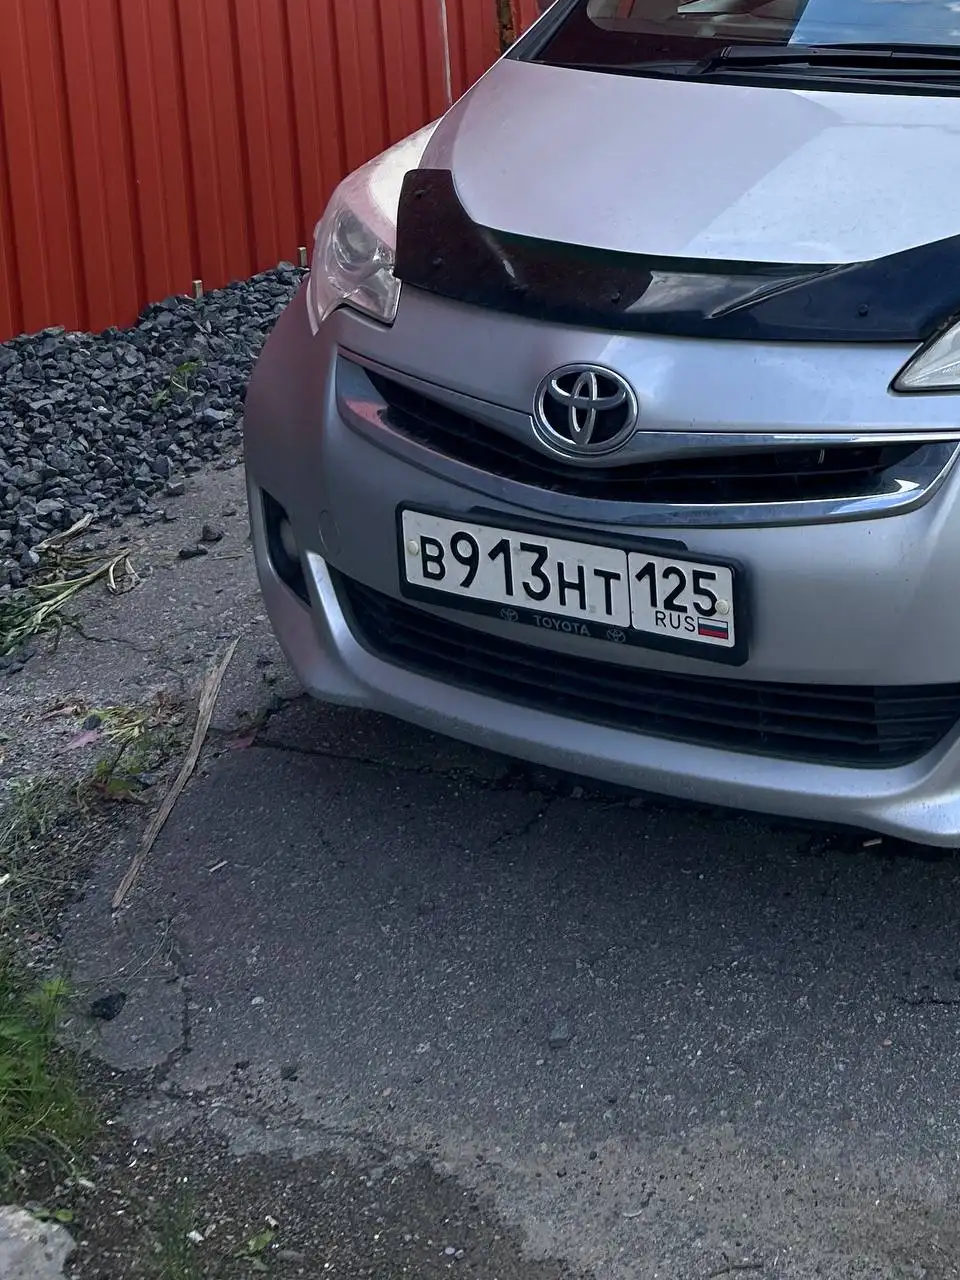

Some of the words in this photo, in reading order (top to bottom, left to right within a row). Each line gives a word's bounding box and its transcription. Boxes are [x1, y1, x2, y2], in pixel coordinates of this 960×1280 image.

[635, 562, 718, 617] 125
[533, 615, 591, 637] TOYOTA
[655, 610, 696, 633] RUS
